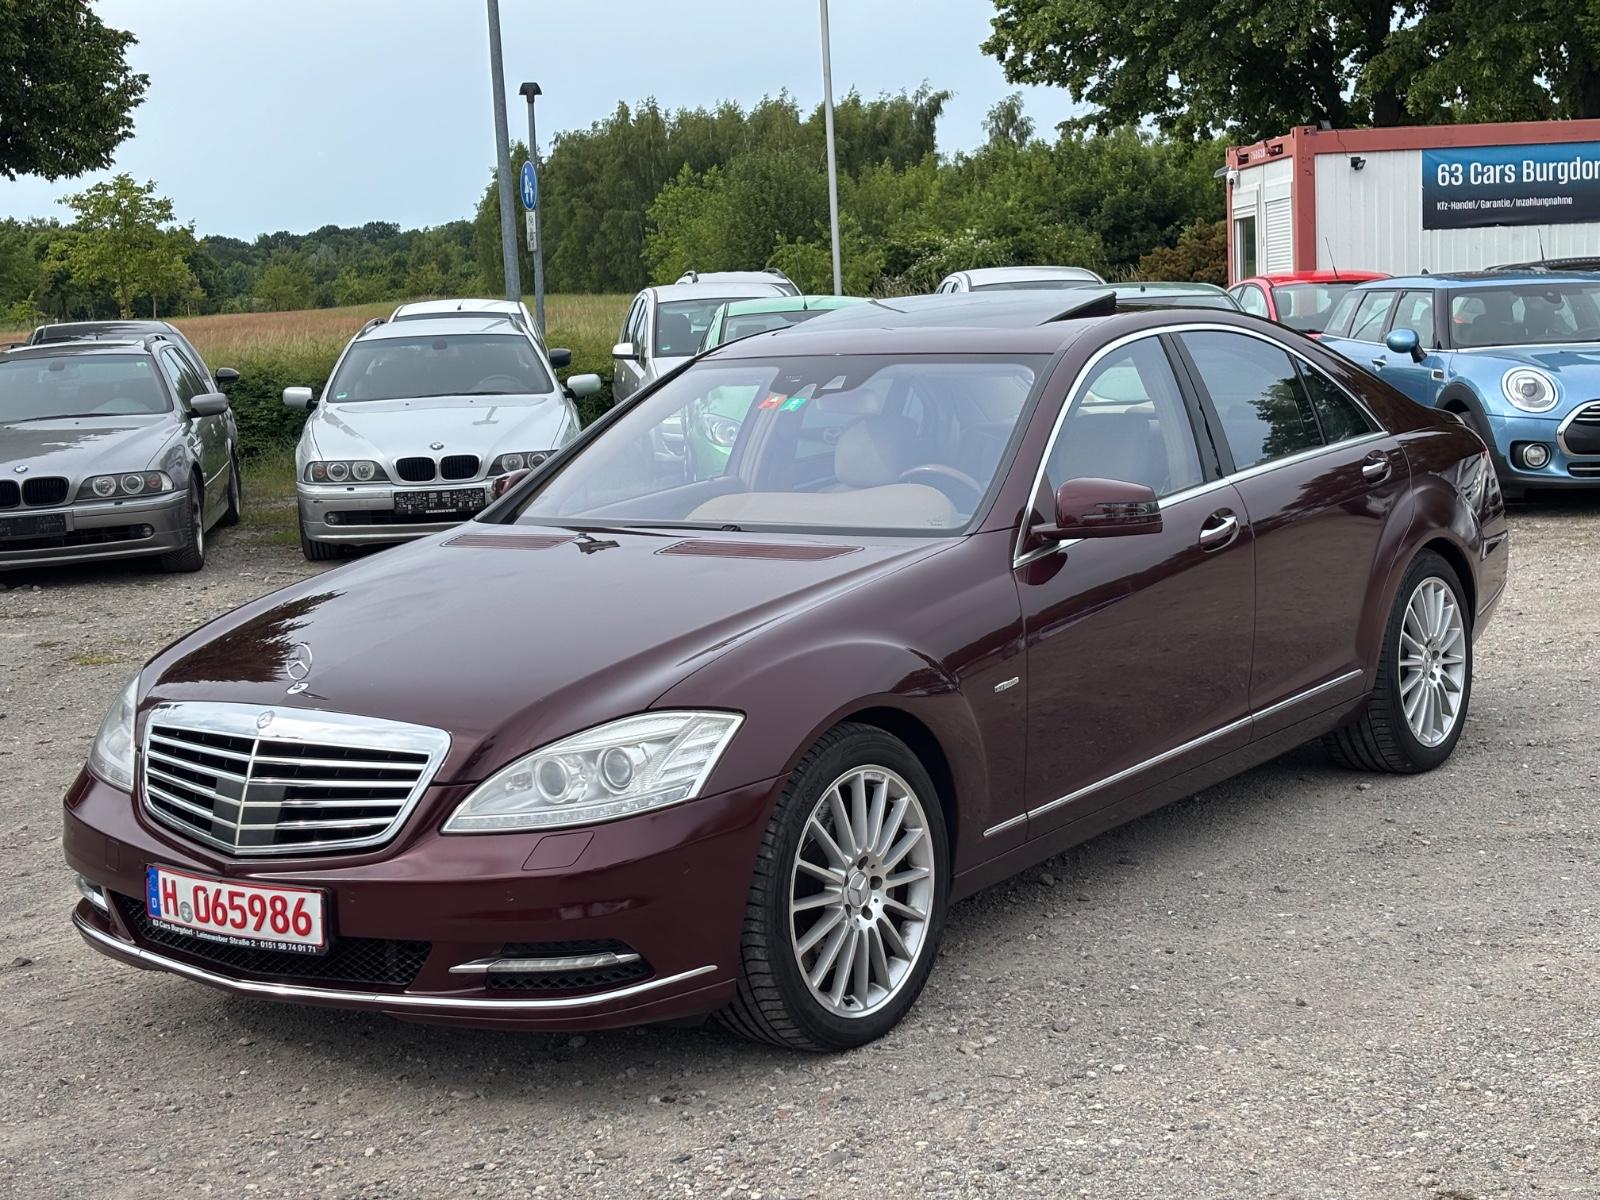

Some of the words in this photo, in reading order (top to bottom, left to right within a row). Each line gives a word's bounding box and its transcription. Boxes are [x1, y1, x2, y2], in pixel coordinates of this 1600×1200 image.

[1437, 163, 1463, 186] 63
[1470, 162, 1516, 185] Cars
[151, 897, 157, 908] D
[161, 877, 180, 917] H
[192, 884, 313, 937] 065986
[160, 921, 171, 930] Cars
[171, 923, 193, 936] Burgdorf
[229, 936, 250, 946] Straße
[260, 941, 276, 949] 0151
[288, 943, 297, 951] 74
[297, 944, 306, 952] 01
[307, 945, 316, 953] 71
